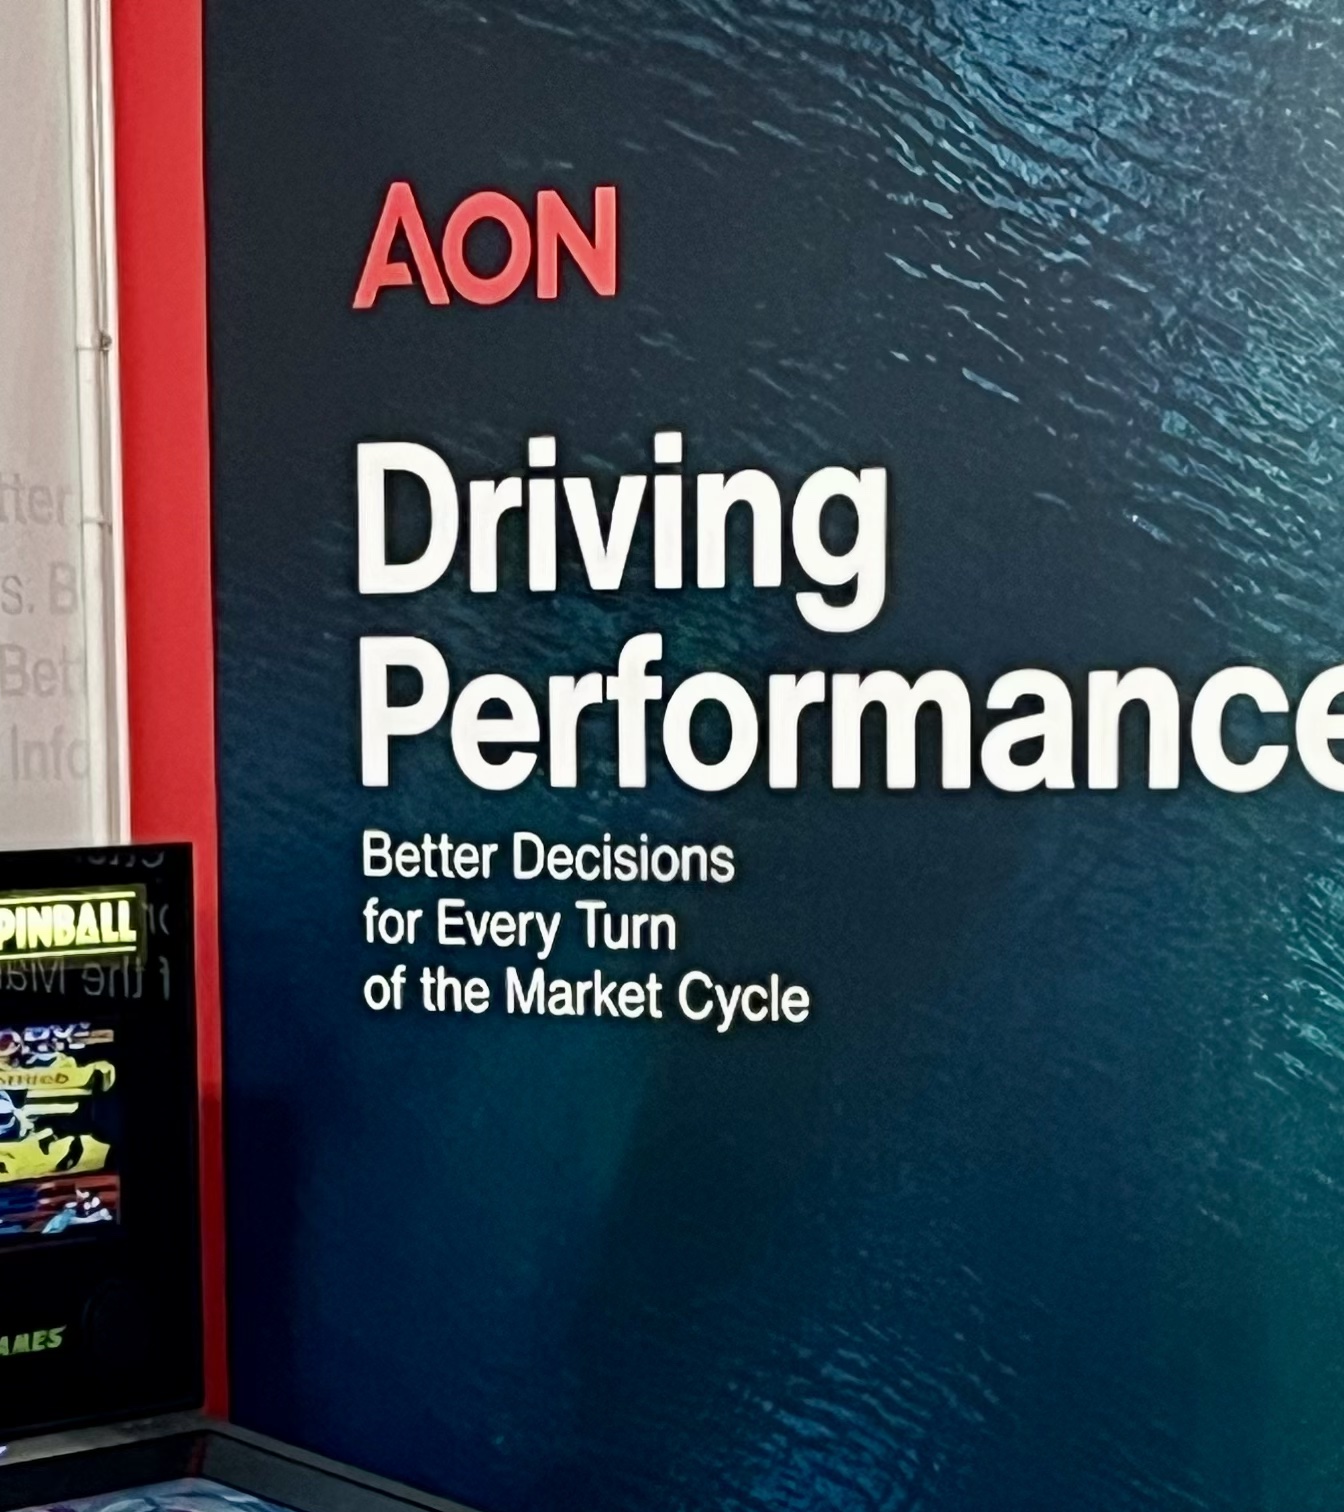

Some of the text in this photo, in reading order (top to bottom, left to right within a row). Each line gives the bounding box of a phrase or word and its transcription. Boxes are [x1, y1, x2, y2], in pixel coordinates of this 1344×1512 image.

[352, 182, 616, 308] AON
[356, 431, 887, 632] Driving
[362, 829, 735, 883] Better Decisions
[362, 896, 676, 960] for Every Turn
[363, 964, 811, 1033] of the Market Cycle
